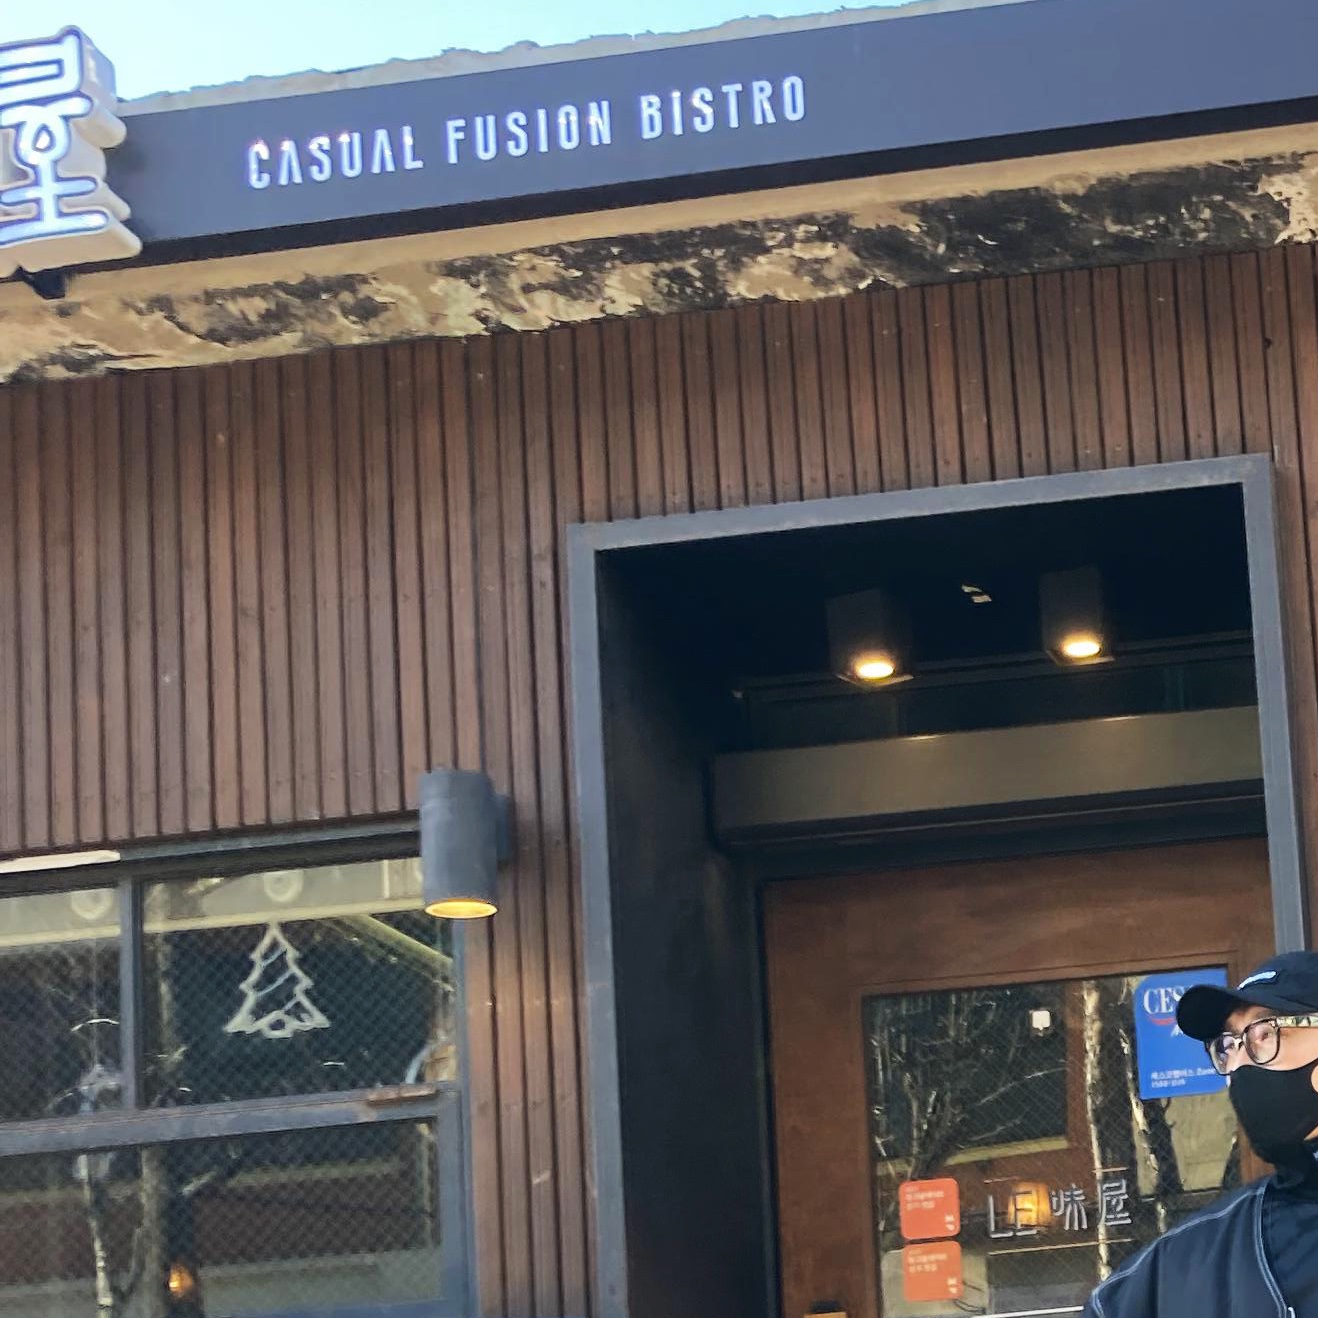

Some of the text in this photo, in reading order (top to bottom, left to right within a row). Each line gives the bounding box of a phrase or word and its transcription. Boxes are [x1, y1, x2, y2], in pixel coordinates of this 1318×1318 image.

[249, 76, 804, 189] CASUAL FUSION BISTRO
[1143, 984, 1193, 1015] CES
